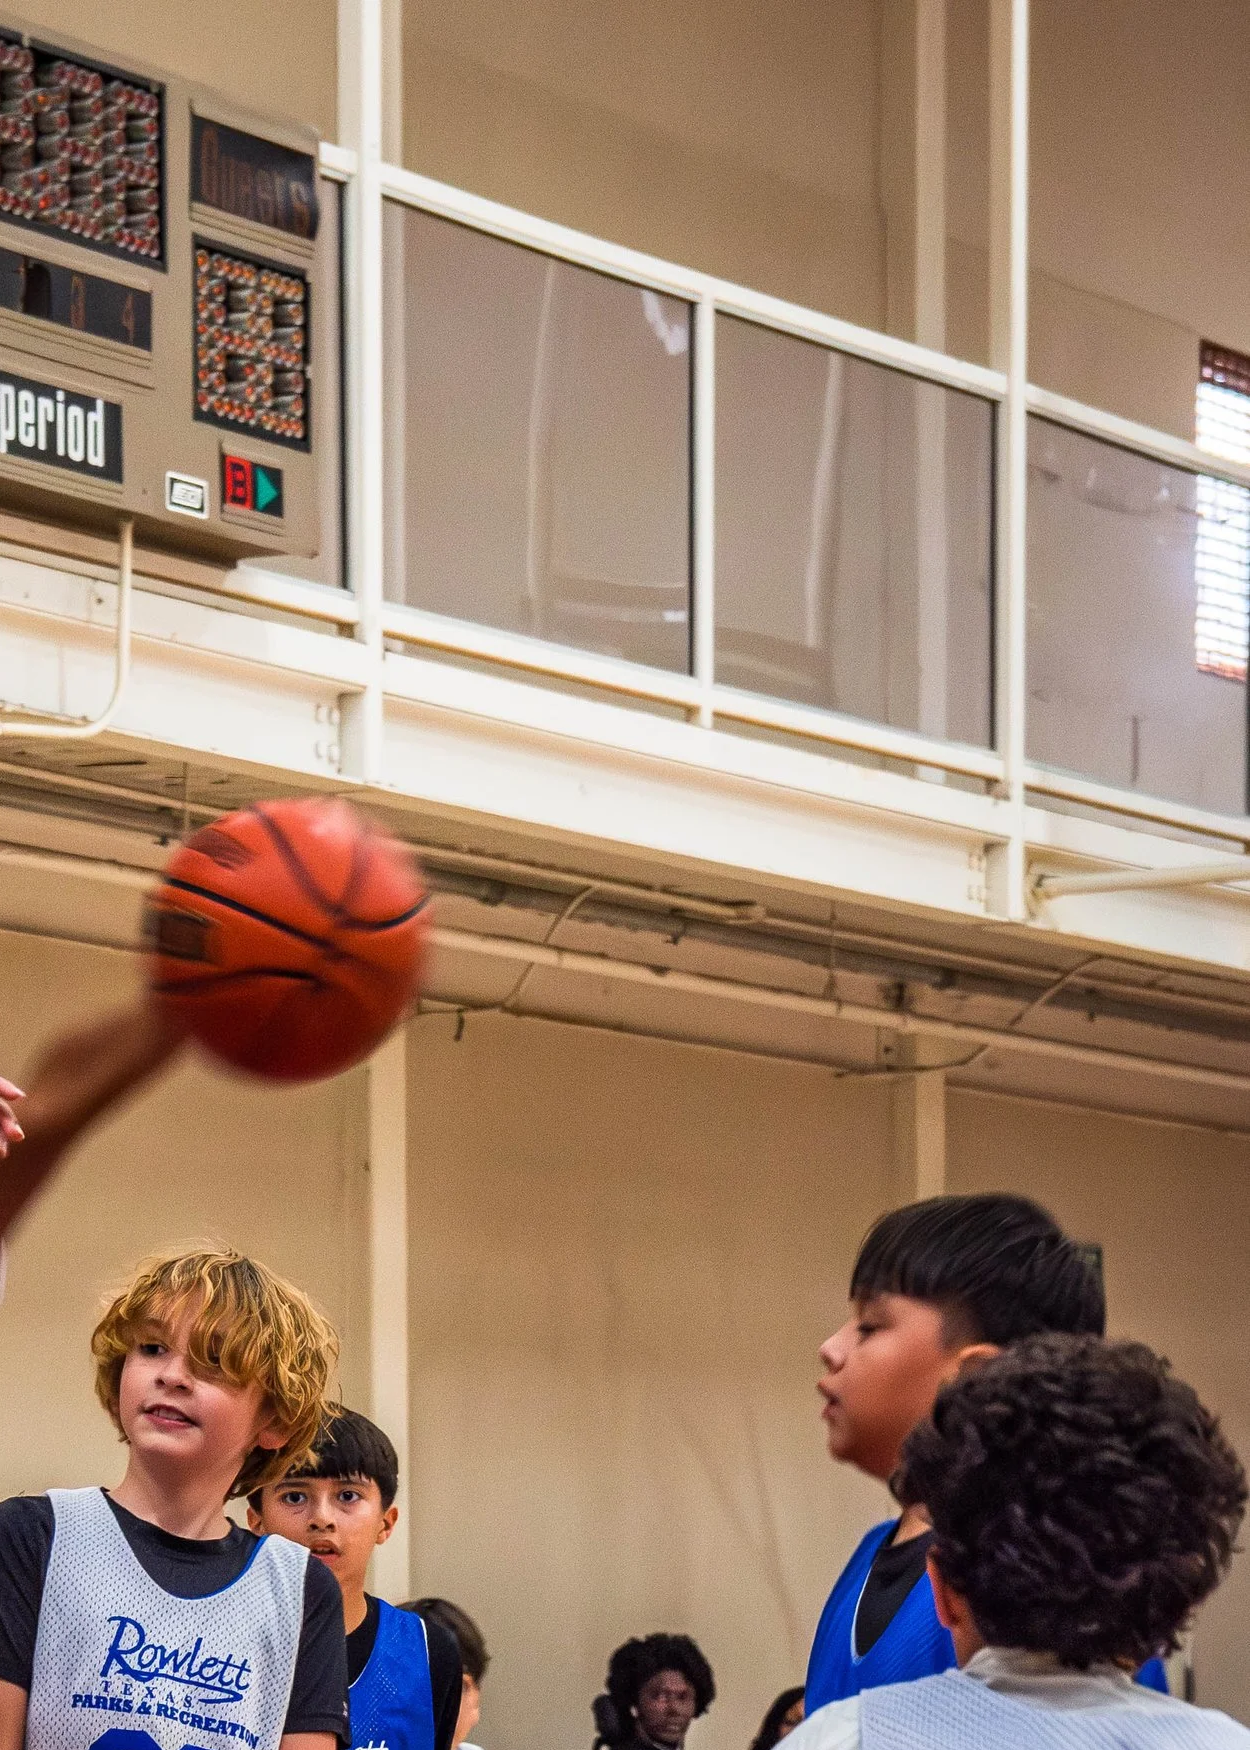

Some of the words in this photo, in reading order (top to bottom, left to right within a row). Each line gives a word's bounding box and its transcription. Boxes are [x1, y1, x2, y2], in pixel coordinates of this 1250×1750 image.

[100, 1615, 252, 1704] Rowlett
[71, 1693, 134, 1715] PARKS
[136, 1701, 152, 1716] &
[155, 1702, 260, 1750] RECREATION
